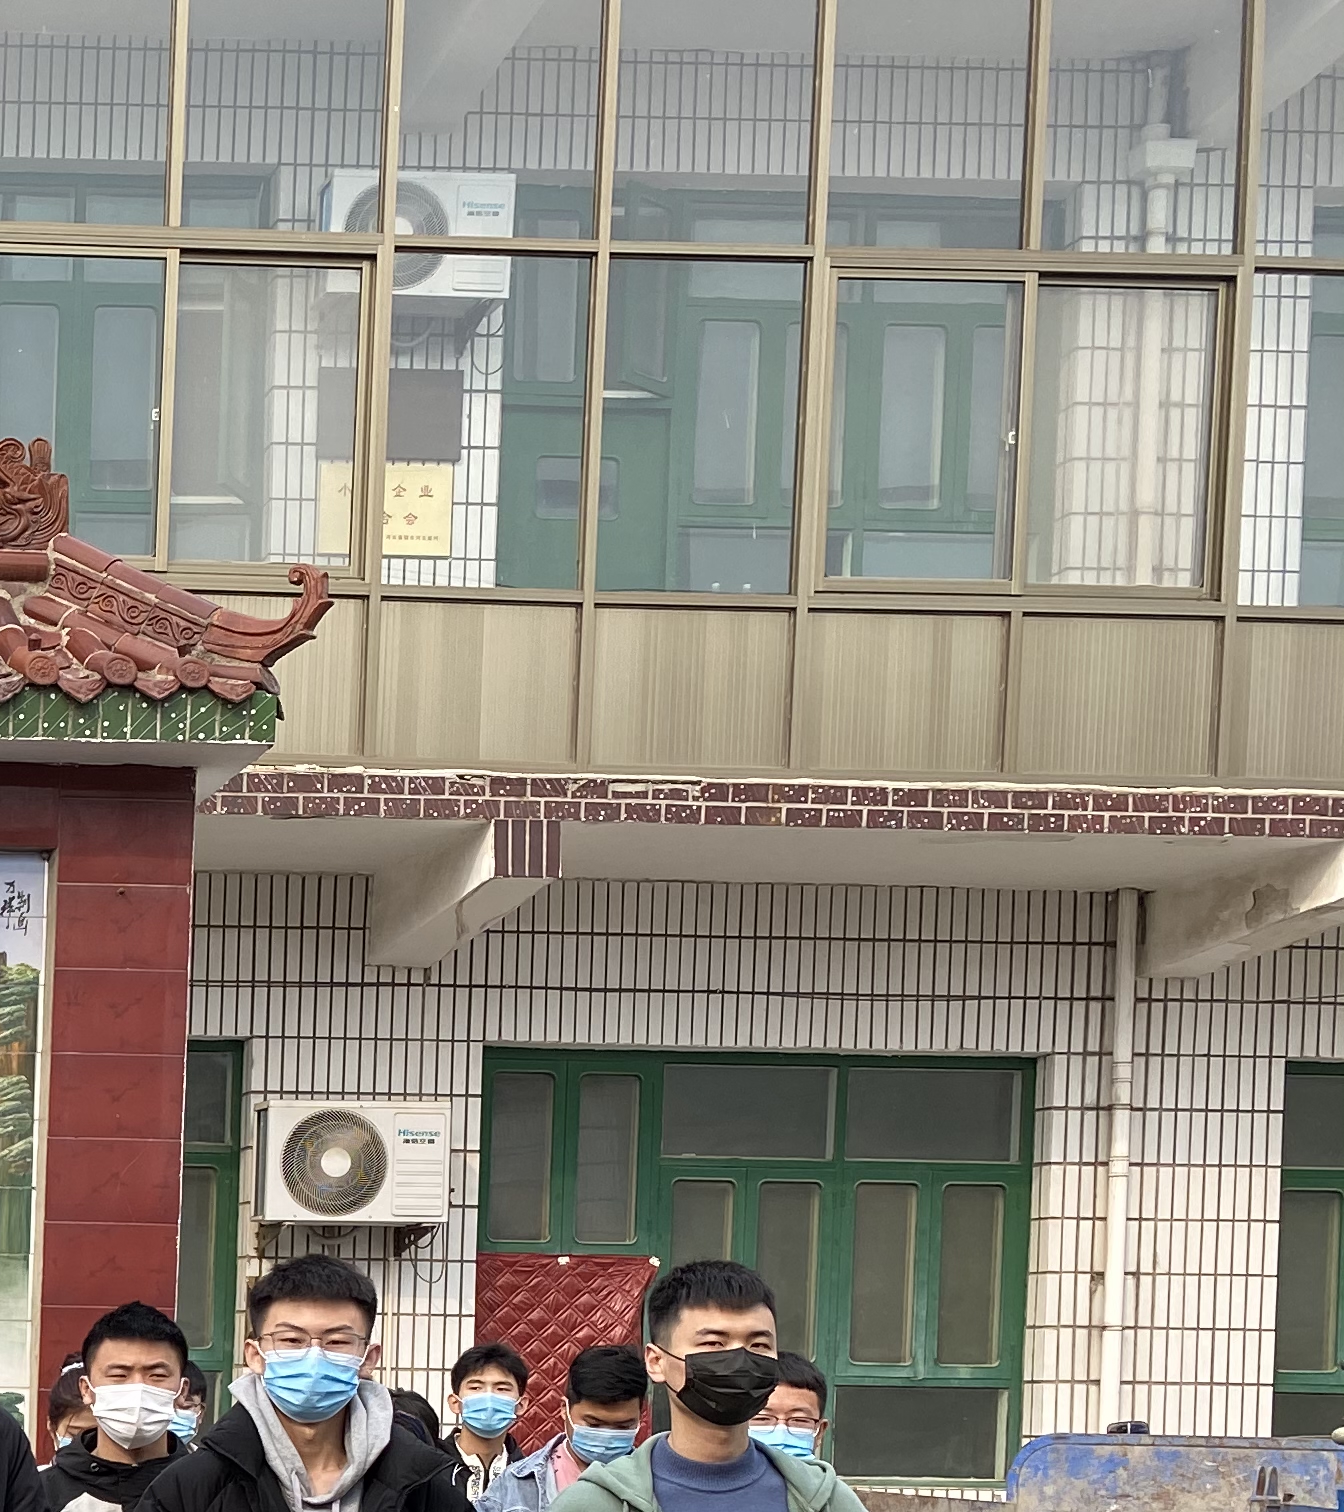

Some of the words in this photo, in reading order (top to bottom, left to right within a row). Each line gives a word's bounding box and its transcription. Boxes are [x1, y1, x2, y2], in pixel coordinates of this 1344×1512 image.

[462, 201, 505, 209] Hisense
[338, 482, 434, 499] 小企业
[397, 1129, 441, 1137] Hisense
